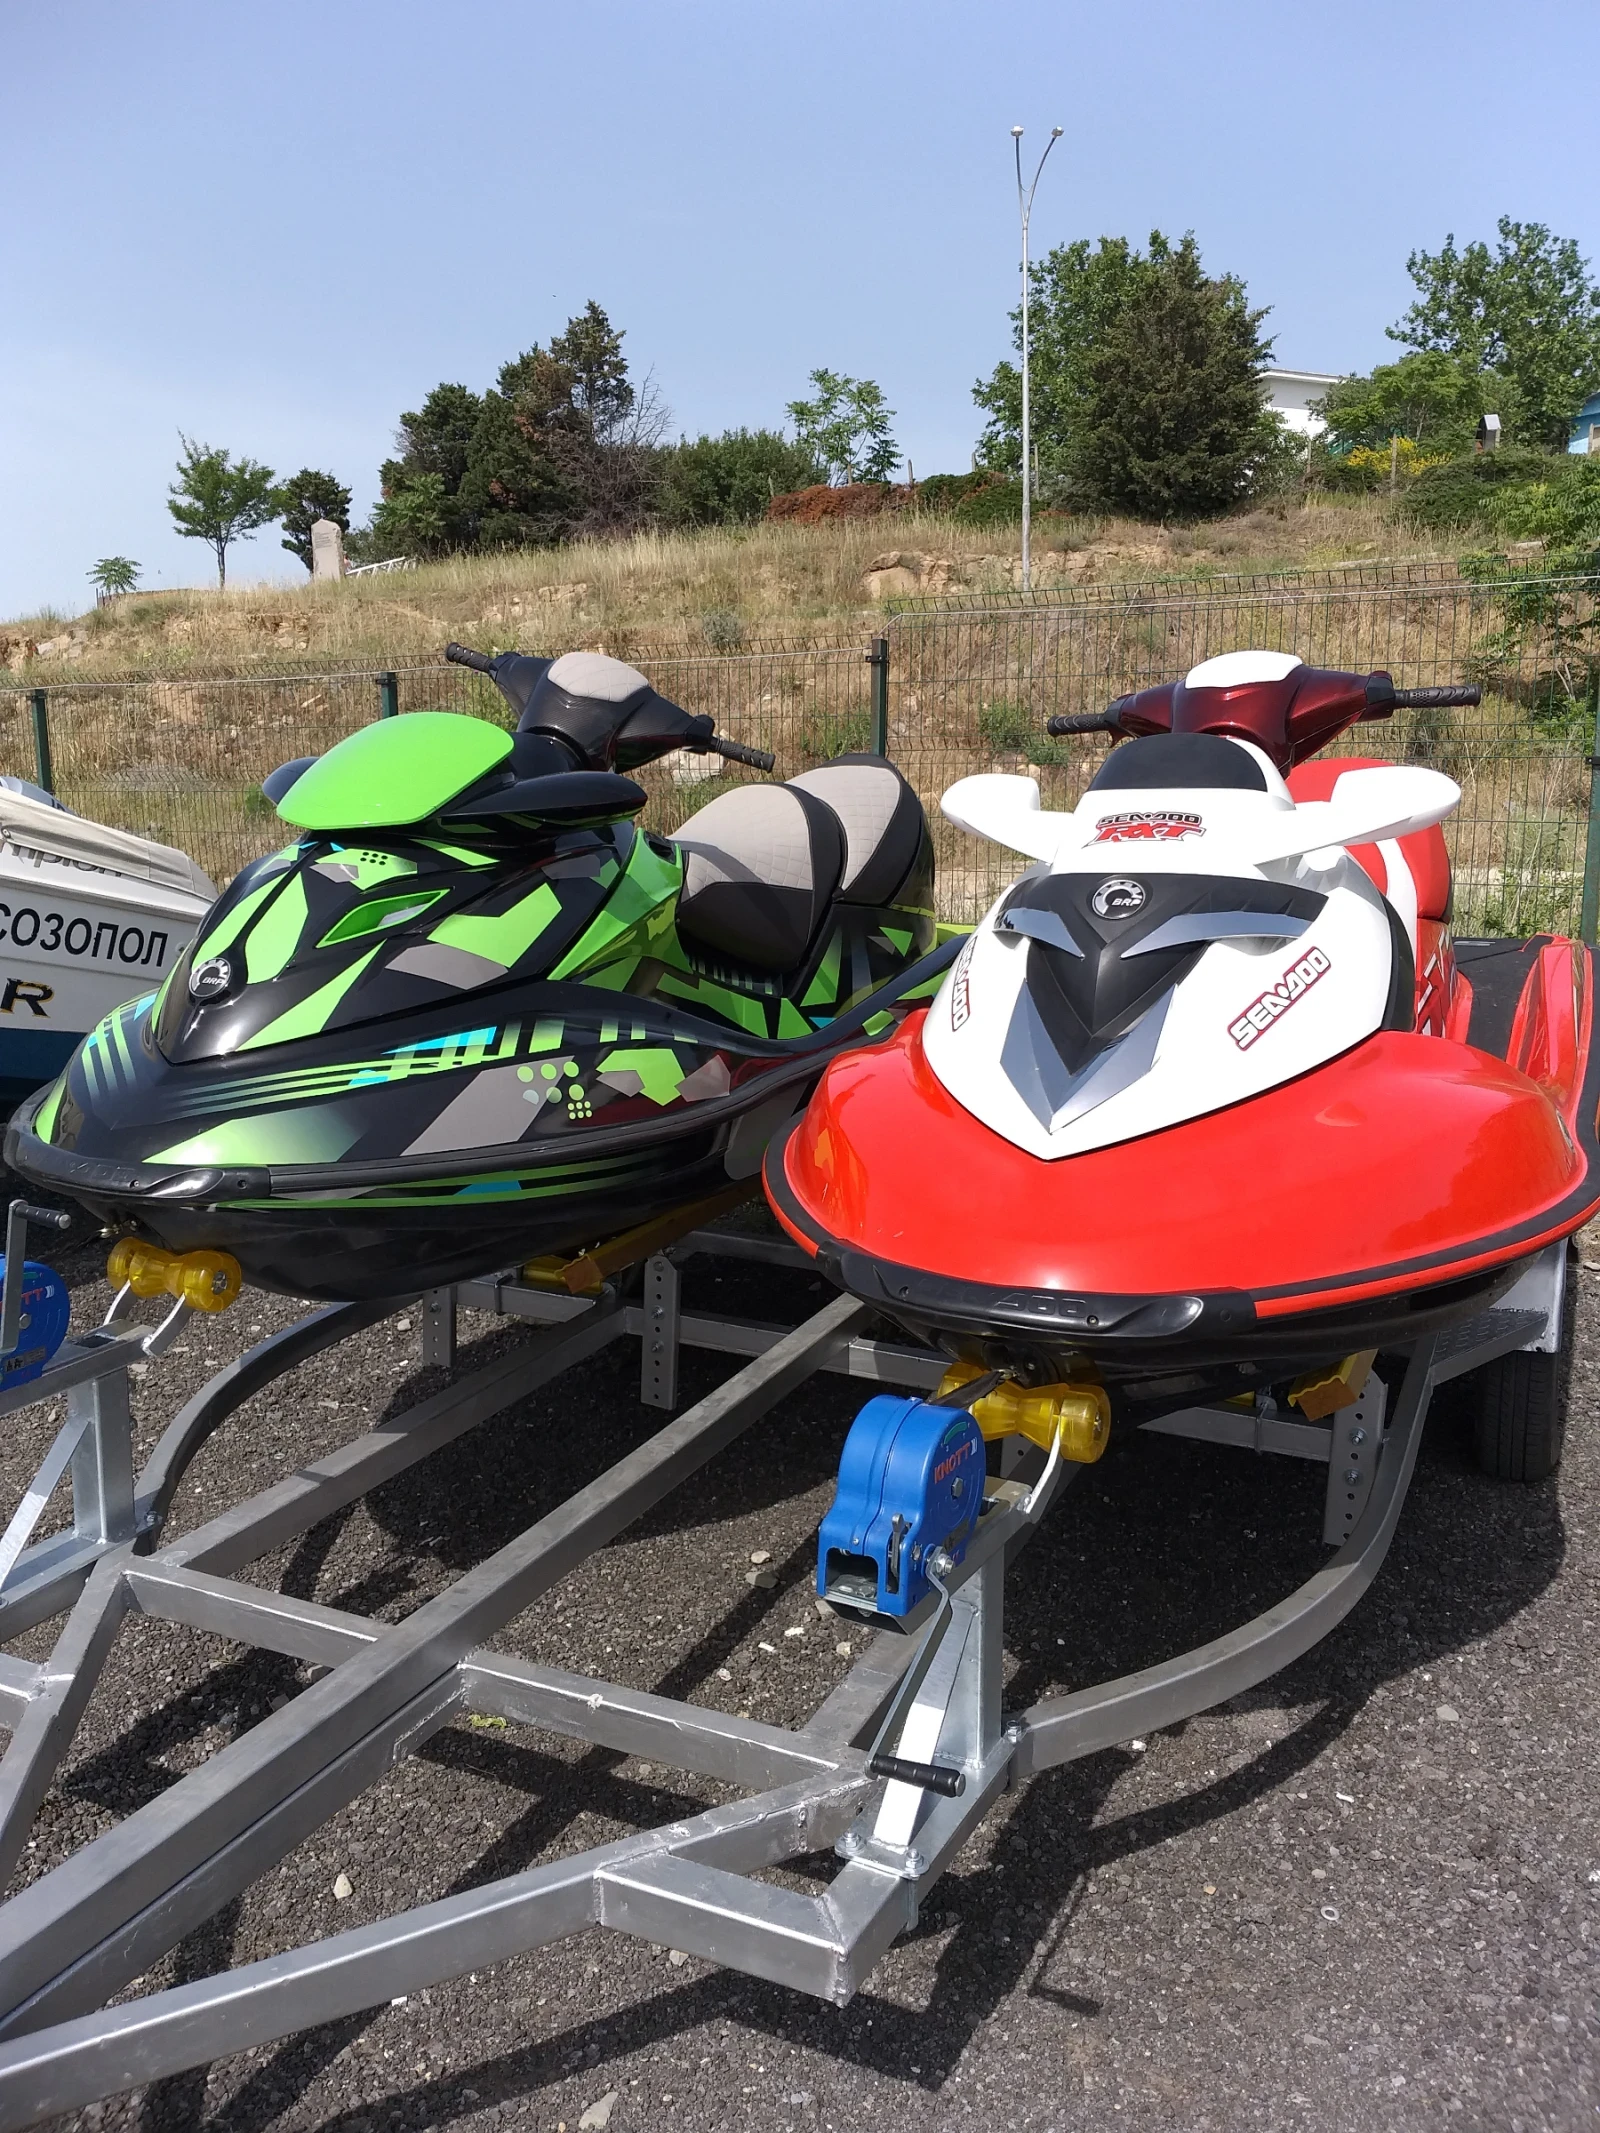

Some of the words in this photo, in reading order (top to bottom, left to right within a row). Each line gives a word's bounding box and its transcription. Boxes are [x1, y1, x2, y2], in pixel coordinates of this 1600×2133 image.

[1093, 823, 1204, 843] RXT
[1111, 897, 1141, 907] BRP
[934, 1441, 971, 1485] KNOTT
